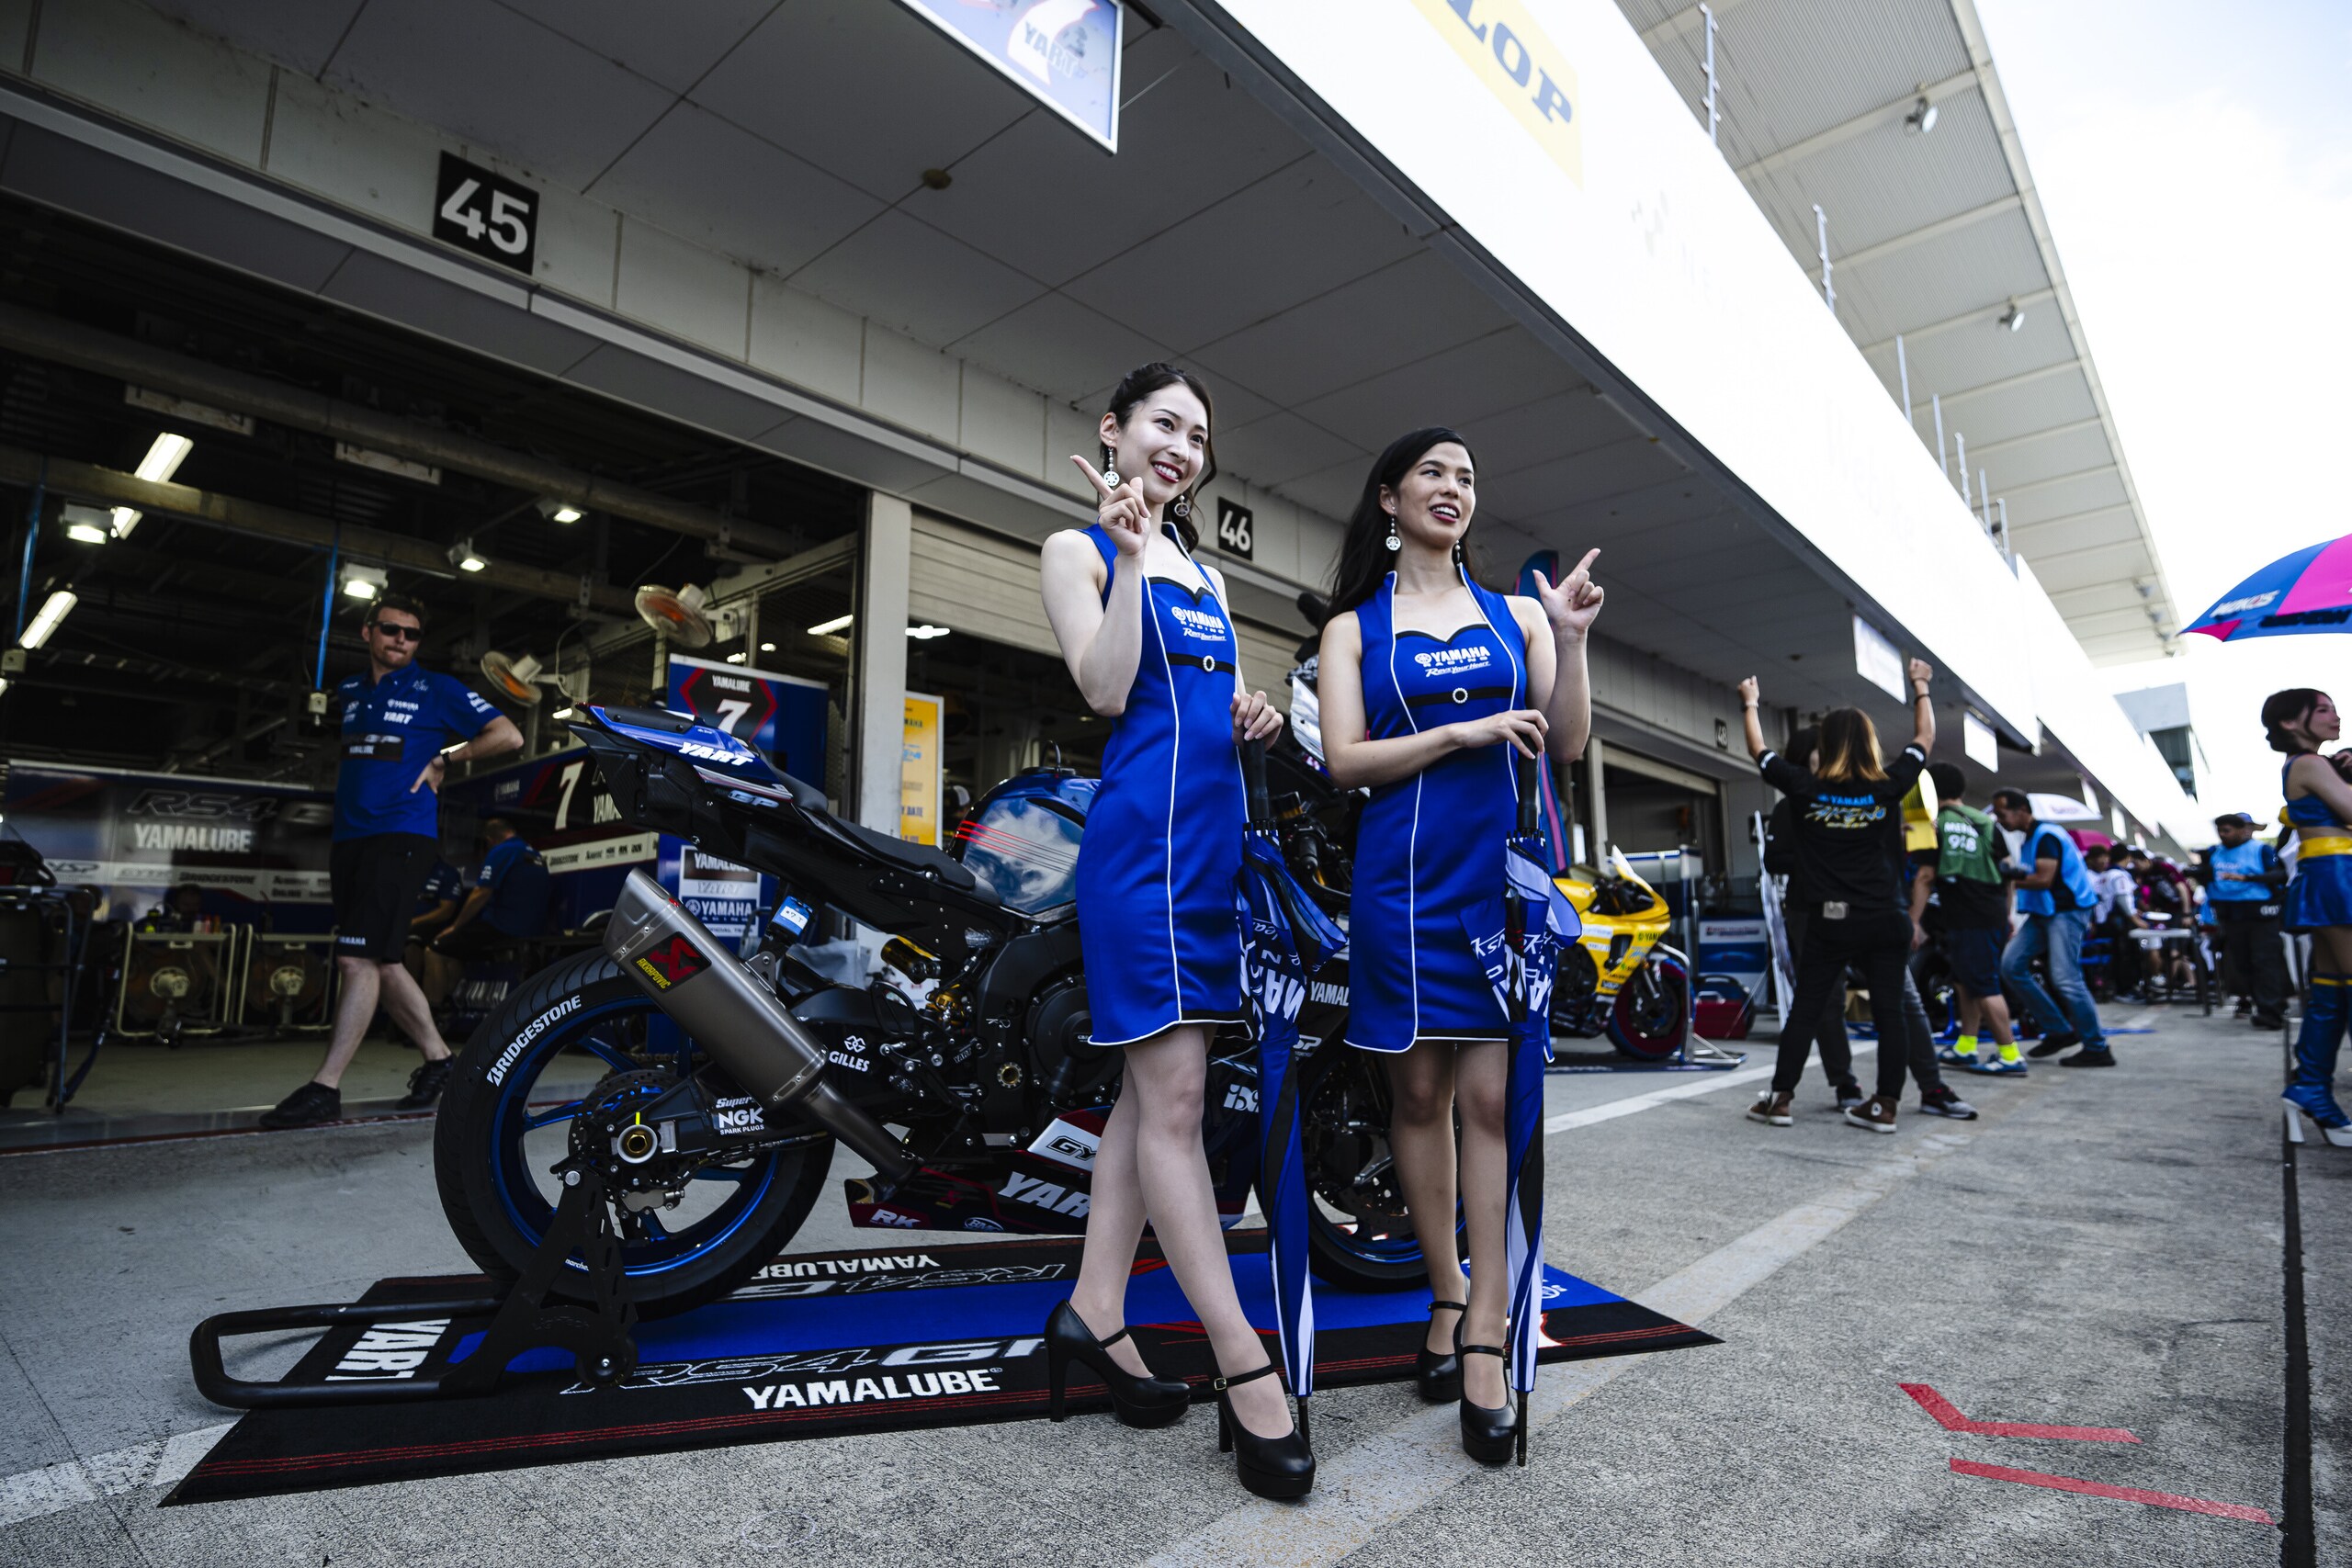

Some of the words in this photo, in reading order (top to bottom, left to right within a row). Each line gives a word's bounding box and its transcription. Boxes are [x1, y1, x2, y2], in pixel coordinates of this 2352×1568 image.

[1023, 20, 1079, 79] YART
[441, 177, 529, 255] 45
[1220, 509, 1251, 552] 46
[1182, 608, 1226, 630] YAMAHA
[1430, 646, 1491, 662] YAMAHA
[712, 674, 752, 693] YAMALUBE
[717, 698, 752, 735] 7
[678, 742, 753, 766] YART
[554, 759, 585, 831] 7
[135, 823, 253, 853] YAMALUBE
[694, 852, 750, 872] YAMALU
[701, 900, 752, 916] YAMAHA
[1310, 981, 1349, 1006] YAMAL
[486, 995, 582, 1087] BRIDGESTONE
[1293, 1034, 1322, 1050] SP
[829, 1050, 871, 1072] GILLES
[716, 1096, 752, 1109] Super
[718, 1107, 764, 1129] NGK
[742, 1123, 765, 1133] PLUGS
[1046, 1134, 1099, 1161] GY
[997, 1170, 1091, 1220] YAR
[869, 1209, 922, 1229] RK
[565, 1258, 590, 1271] marche
[741, 1368, 1001, 1411] YAMALUBE
